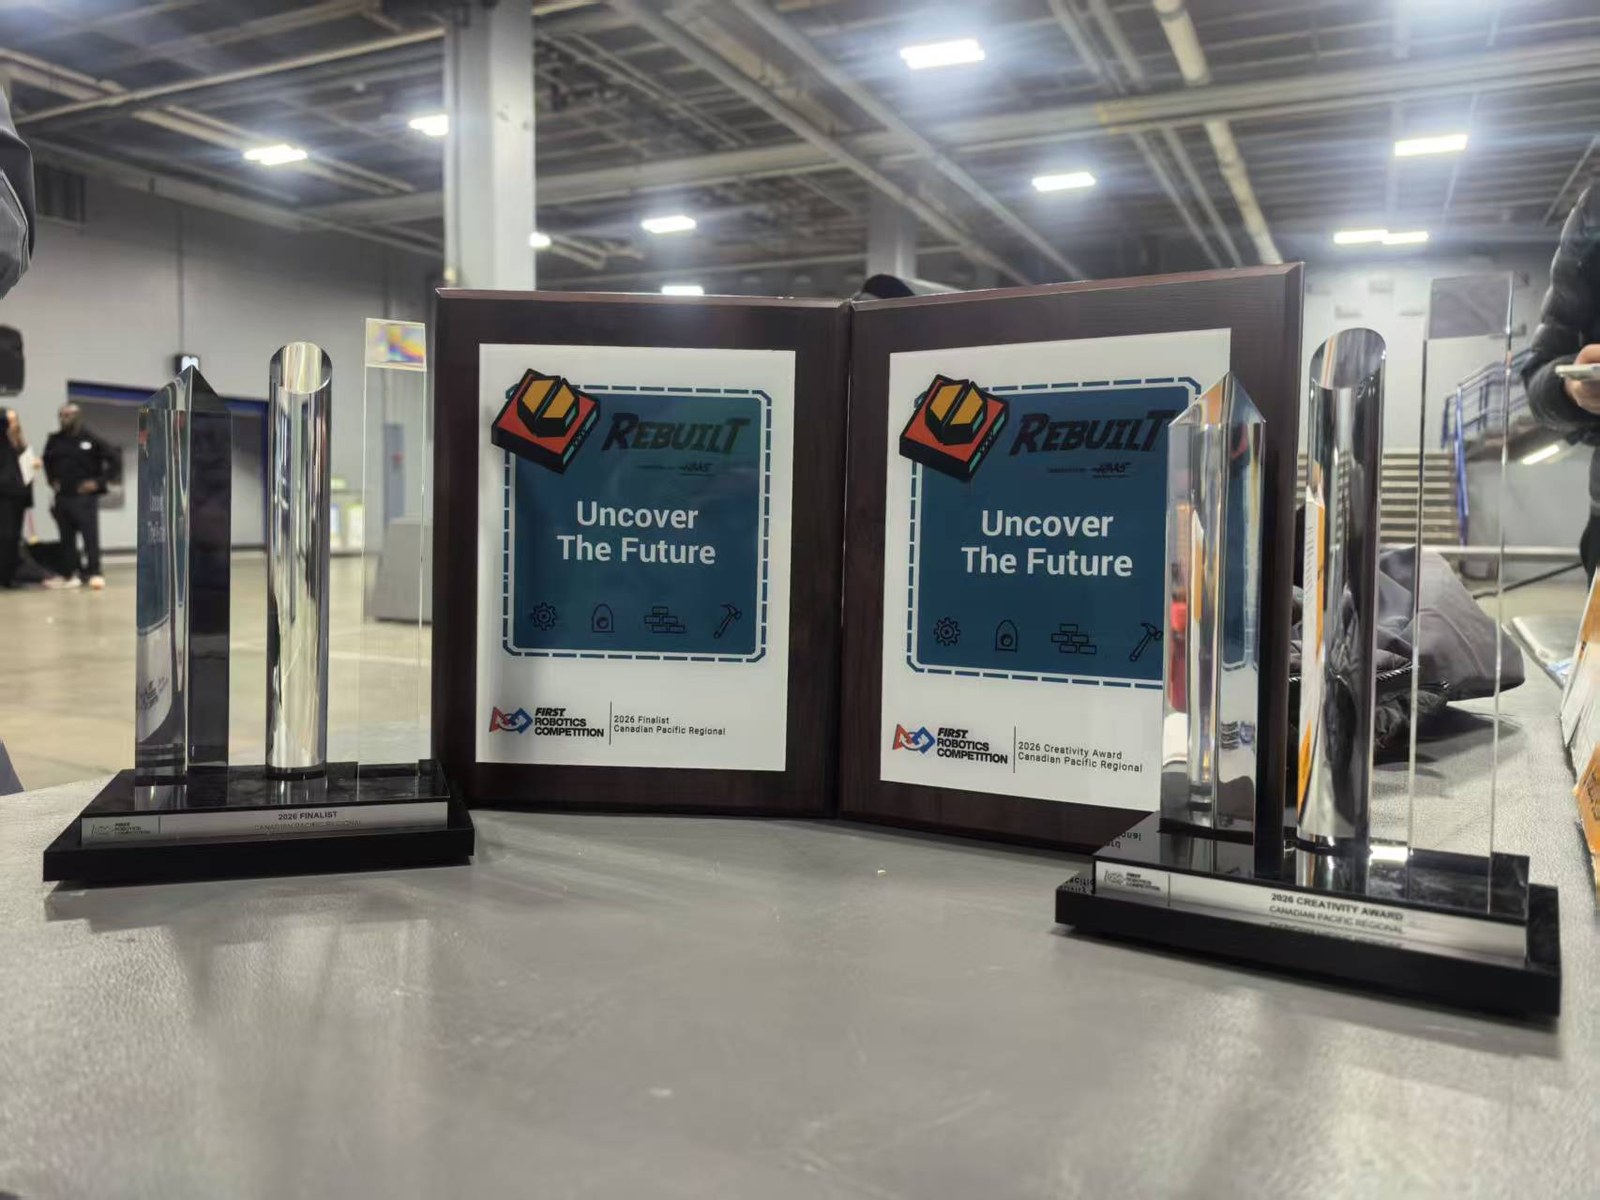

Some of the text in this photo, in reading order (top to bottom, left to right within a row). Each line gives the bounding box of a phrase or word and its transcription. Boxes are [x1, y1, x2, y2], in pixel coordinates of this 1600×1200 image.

[576, 500, 699, 529] Uncover
[981, 509, 1114, 538] Uncover
[557, 534, 716, 565] The Future
[961, 545, 1133, 577] The Future
[535, 707, 566, 717] FIRST
[534, 716, 587, 727] ROBOTICS
[613, 715, 670, 725] 2026 Finalist
[534, 727, 605, 738] COMPETITION
[613, 724, 726, 737] Canadian Pacific Regional
[937, 727, 968, 739] FIRST
[936, 738, 990, 751] ROBOTICS
[1018, 741, 1123, 760] 2026 Creativity Award
[936, 748, 1008, 765] COMPETITION
[1018, 752, 1143, 773] Canadian Pacific Regional
[278, 811, 338, 821] 2026 FINALIST
[1269, 905, 1316, 920] CANADIAN
[1271, 893, 1404, 921] 2026 CREATIVITY AWARD
